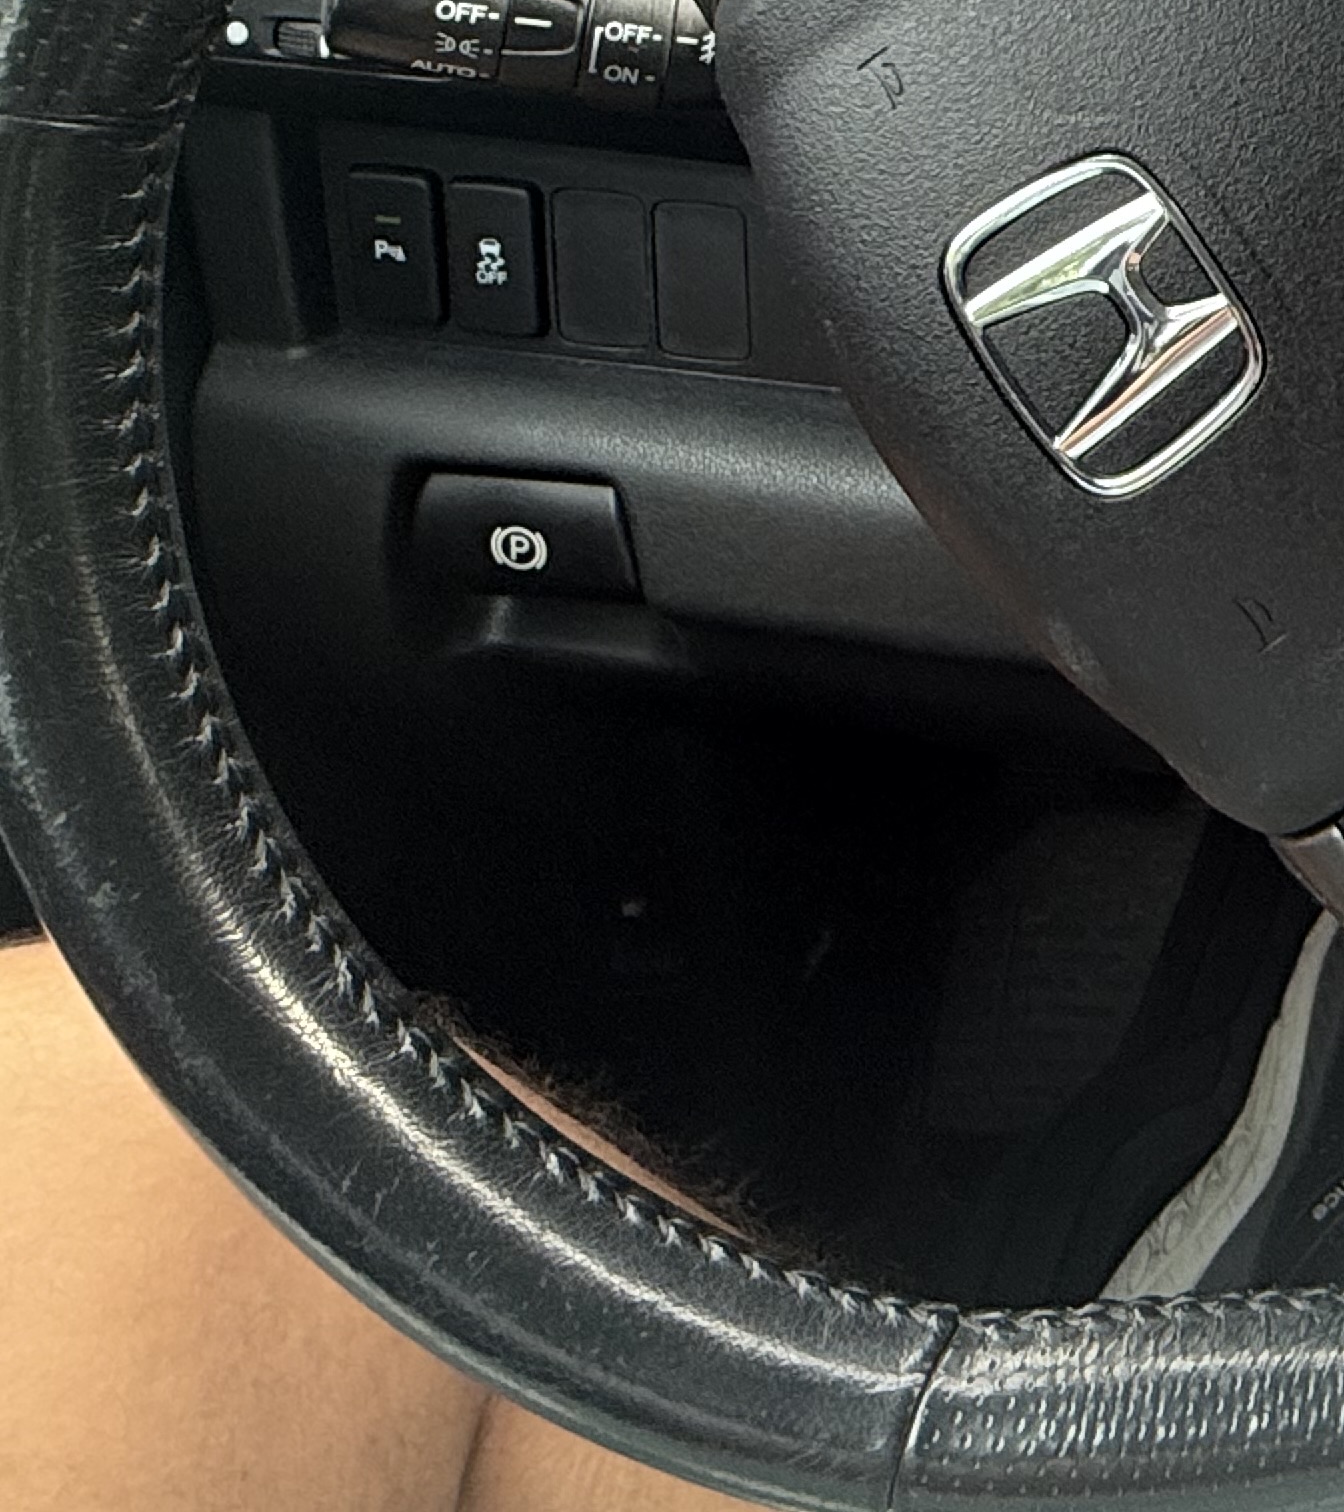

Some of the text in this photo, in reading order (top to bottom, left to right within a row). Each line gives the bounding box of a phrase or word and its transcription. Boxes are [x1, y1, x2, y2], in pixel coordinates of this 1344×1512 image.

[435, 0, 488, 23] OFF
[604, 22, 652, 45] OFF
[410, 58, 476, 77] AUTO
[603, 66, 639, 85] ON
[476, 268, 508, 286] OFF
